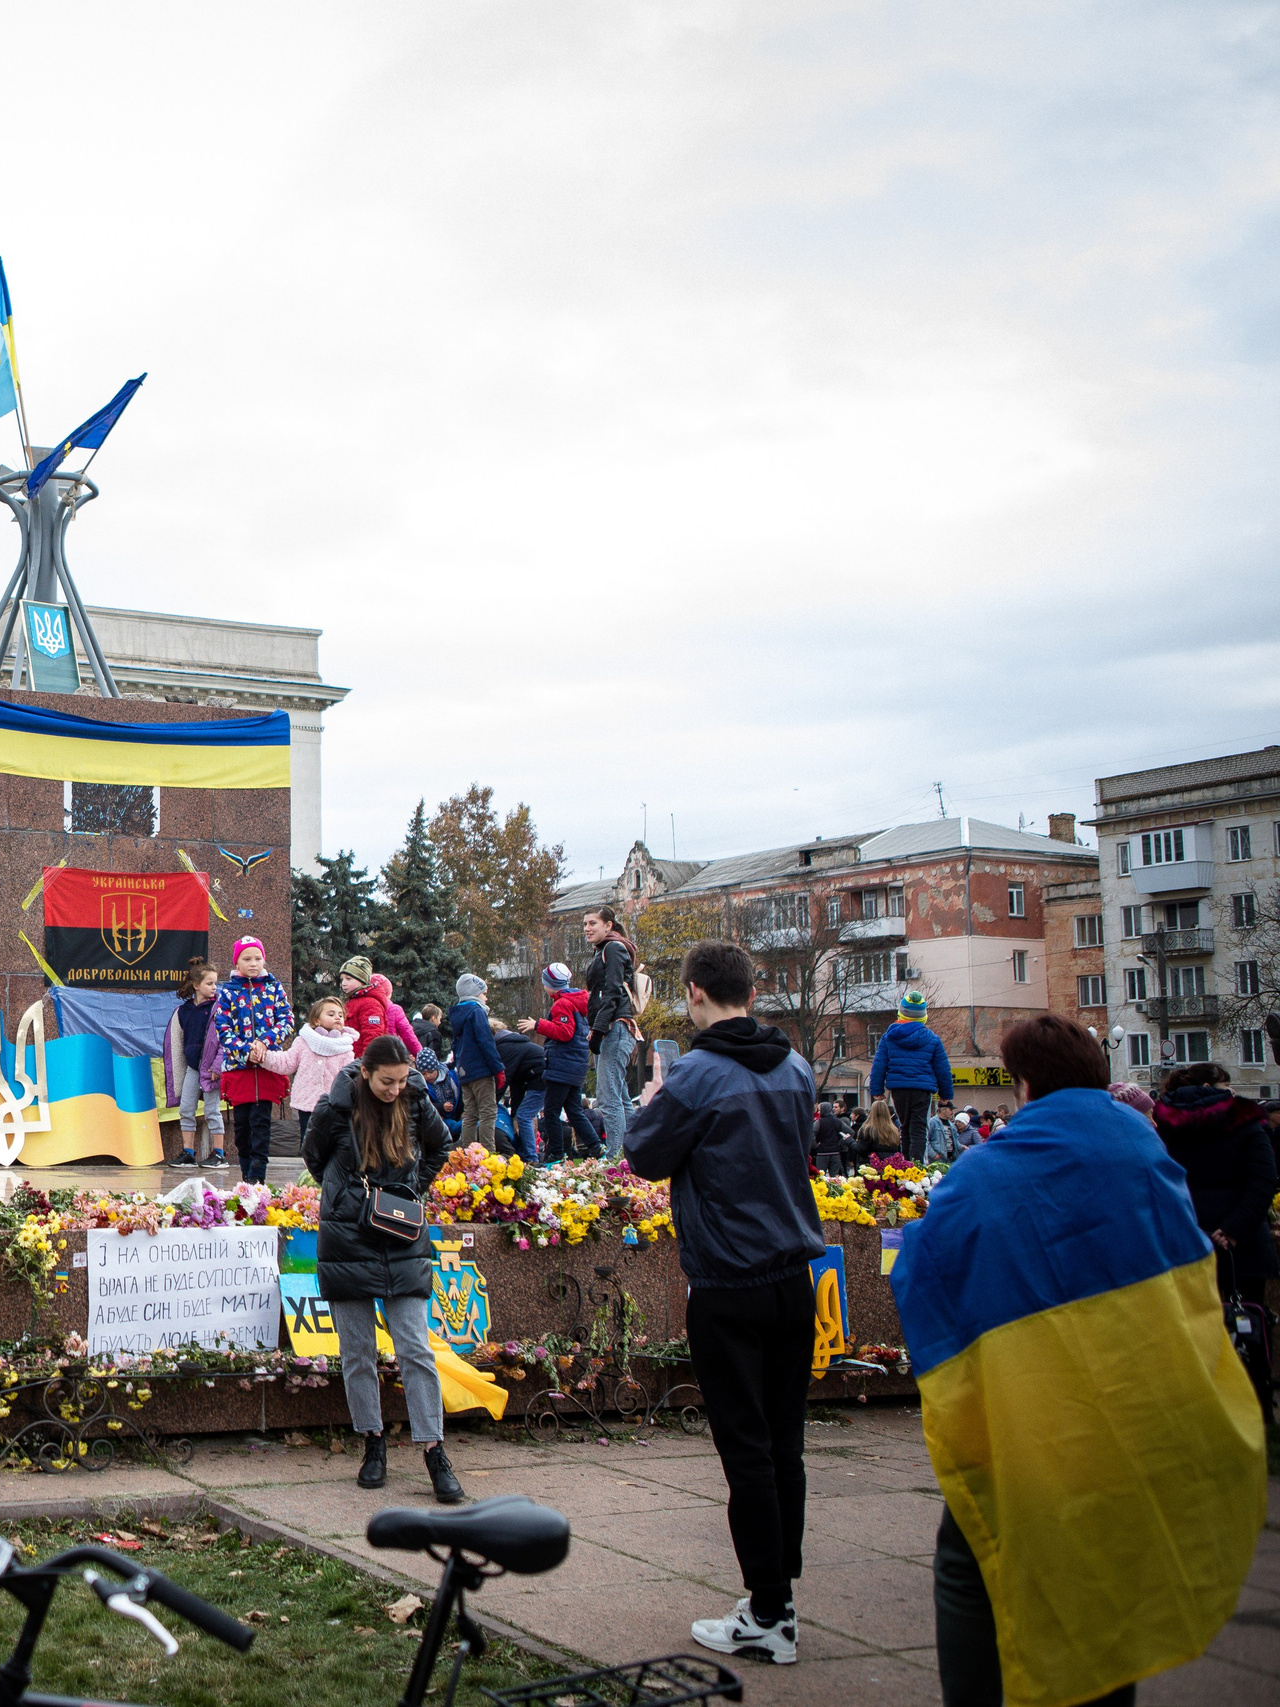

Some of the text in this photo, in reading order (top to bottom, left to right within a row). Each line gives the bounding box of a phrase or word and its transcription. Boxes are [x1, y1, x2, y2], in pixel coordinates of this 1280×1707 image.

[92, 876, 166, 890] УКРАЇНСЬКА
[68, 968, 151, 981] ДОБРОВОЛЬЧА
[118, 1246, 140, 1264] НА
[149, 1238, 228, 1263] ОНОВЛЕНІЙ
[237, 1238, 274, 1259] ЗЕМЛІ
[99, 1275, 139, 1297] ВРАГА
[144, 1274, 159, 1293] НЕ
[107, 1304, 139, 1324] БУДЕ
[183, 1297, 212, 1318] БУДЕ
